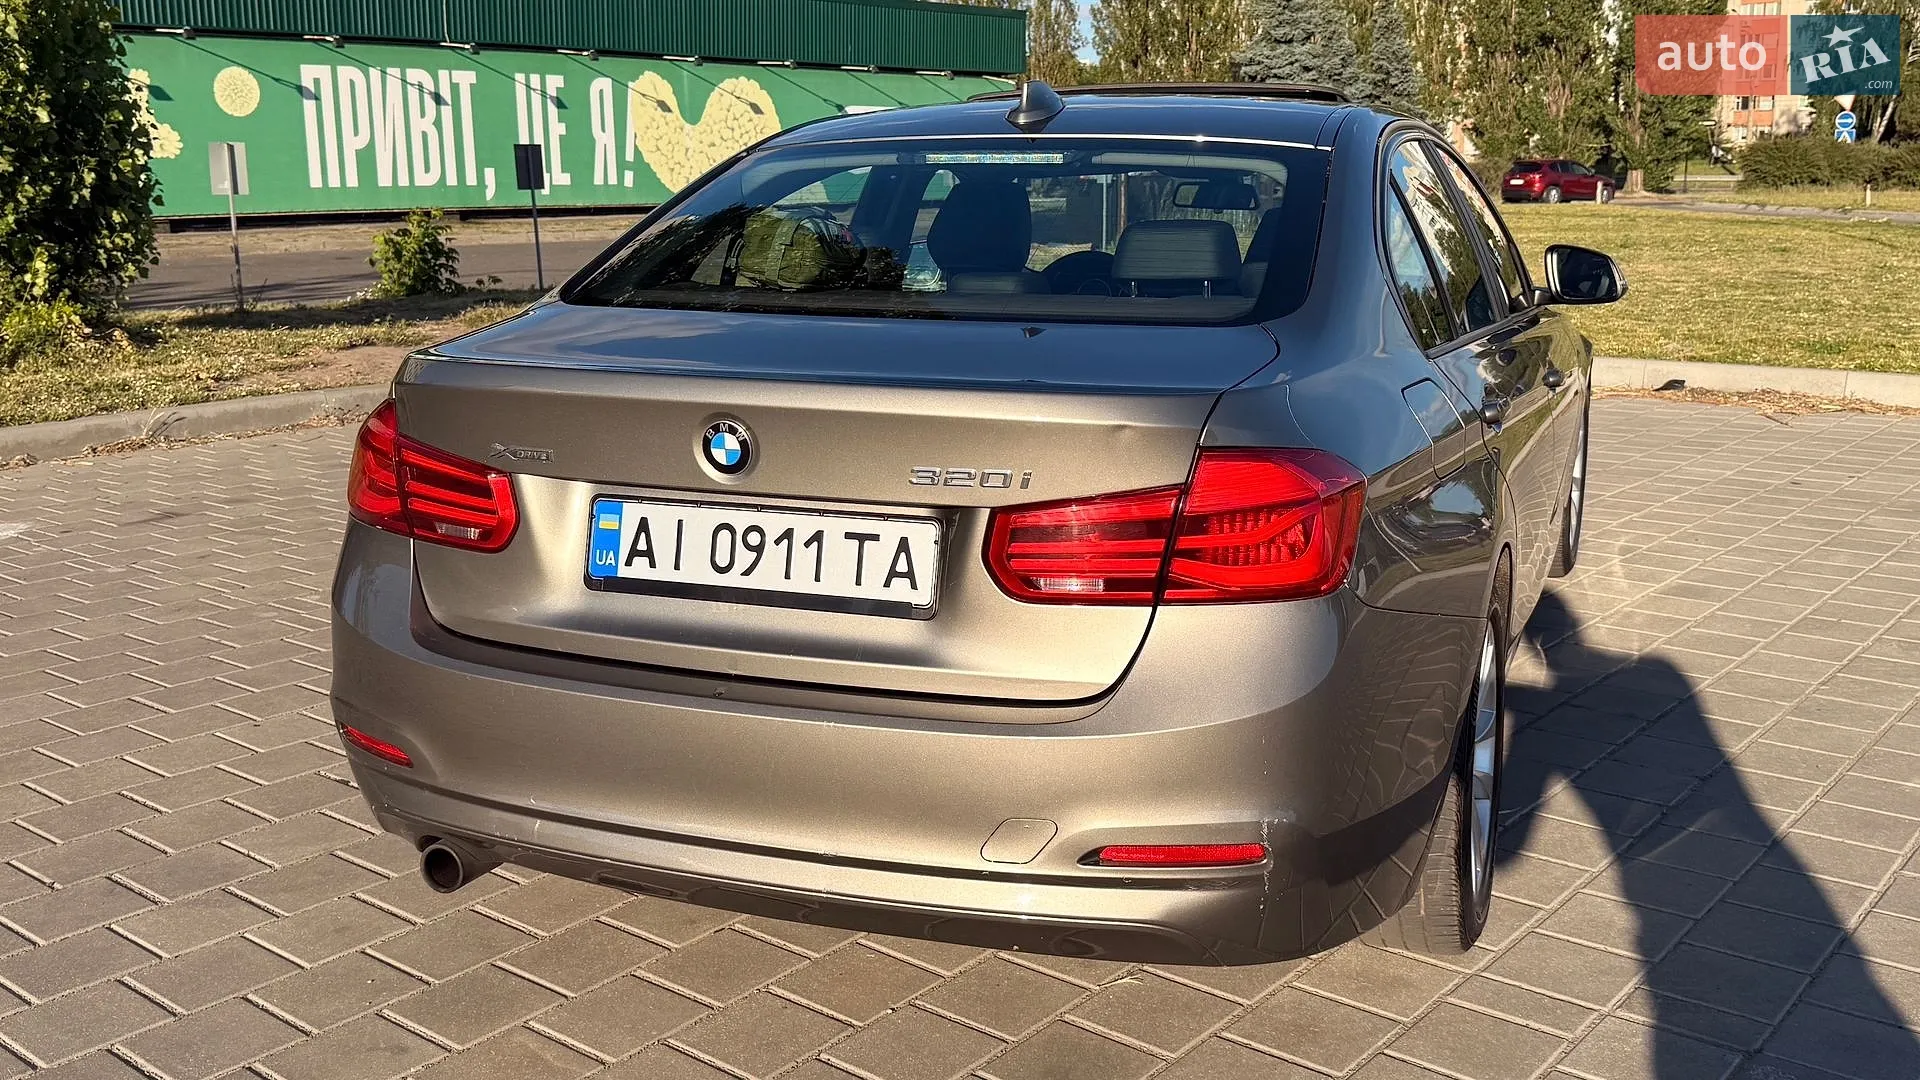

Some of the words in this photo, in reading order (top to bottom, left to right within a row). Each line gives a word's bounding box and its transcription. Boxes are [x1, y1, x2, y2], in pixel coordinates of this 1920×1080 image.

[300, 65, 496, 200] ПРИВІТ,
[514, 73, 571, 195] ЦЕ
[590, 77, 637, 187] Я!
[705, 422, 746, 441] BMW
[909, 467, 1032, 489] 320i
[596, 549, 616, 566] UA
[624, 517, 684, 571] AI
[710, 522, 824, 582] 0911
[844, 531, 919, 590] TA
